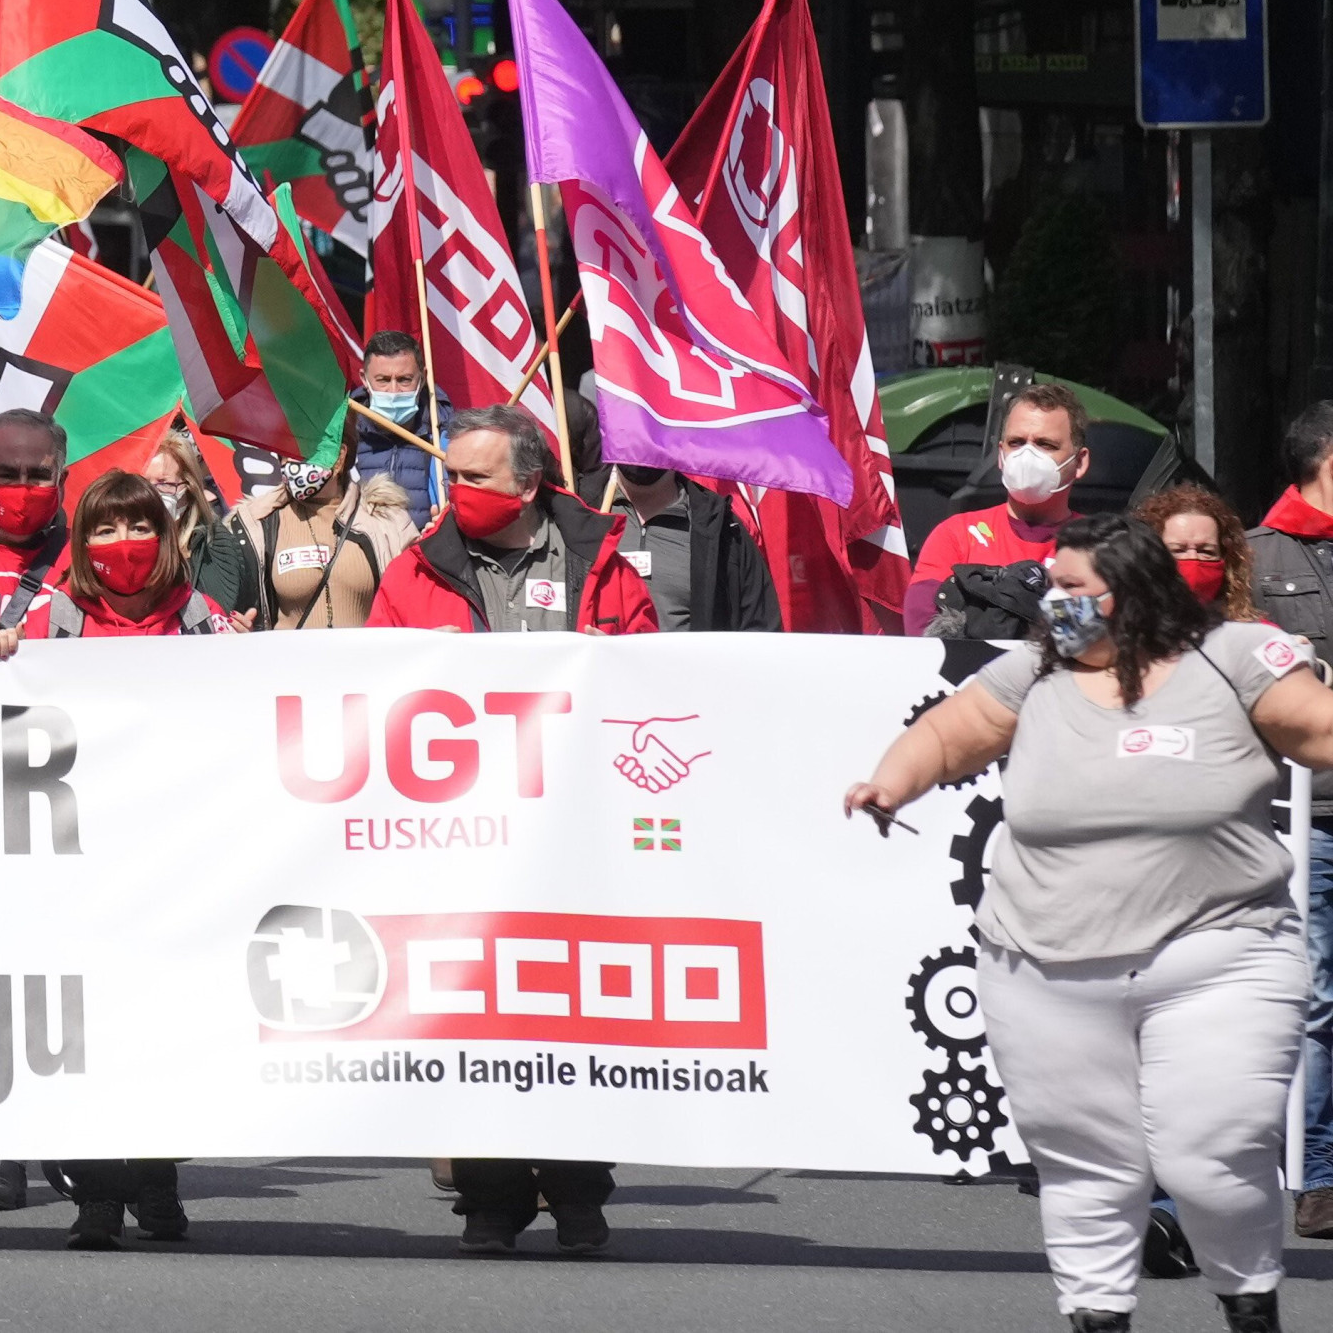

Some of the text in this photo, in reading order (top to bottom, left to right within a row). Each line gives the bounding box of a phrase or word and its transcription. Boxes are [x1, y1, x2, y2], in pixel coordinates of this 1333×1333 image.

[275, 688, 572, 804] UGT
[343, 816, 509, 853] EUSKADI
[406, 936, 740, 1022] CCOO
[260, 1049, 770, 1094] euskadiko langile komisioak
